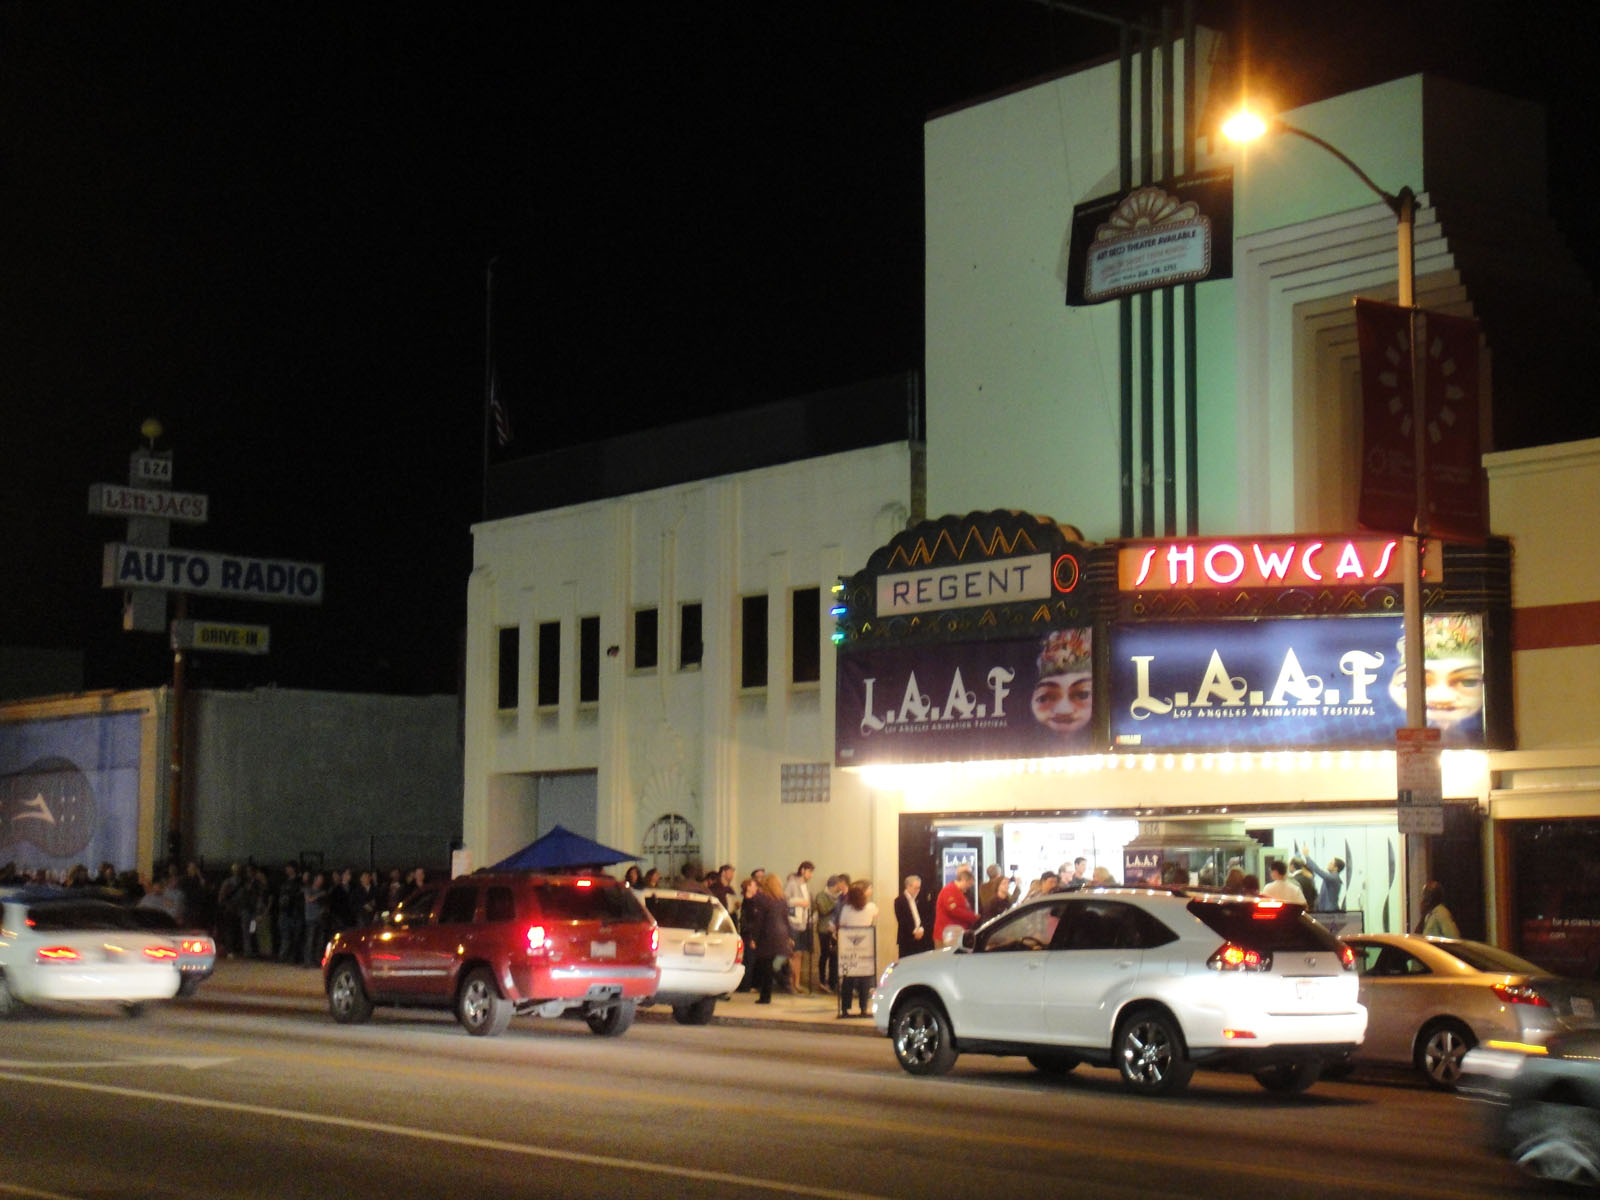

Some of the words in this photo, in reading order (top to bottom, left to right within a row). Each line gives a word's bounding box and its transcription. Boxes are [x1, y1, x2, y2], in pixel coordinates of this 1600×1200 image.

[1127, 237, 1156, 252] THEATER
[1157, 229, 1196, 245] AVAILABLE
[119, 550, 209, 587] AUTO
[220, 559, 319, 597] RADIO
[893, 564, 1032, 606] REGENT
[1135, 542, 1427, 586] SHOWCAS
[1173, 708, 1193, 719] LOS
[1197, 707, 1247, 719] ANGELES
[1252, 706, 1318, 718] ANIMATION
[1322, 705, 1376, 717] FESTIVAL
